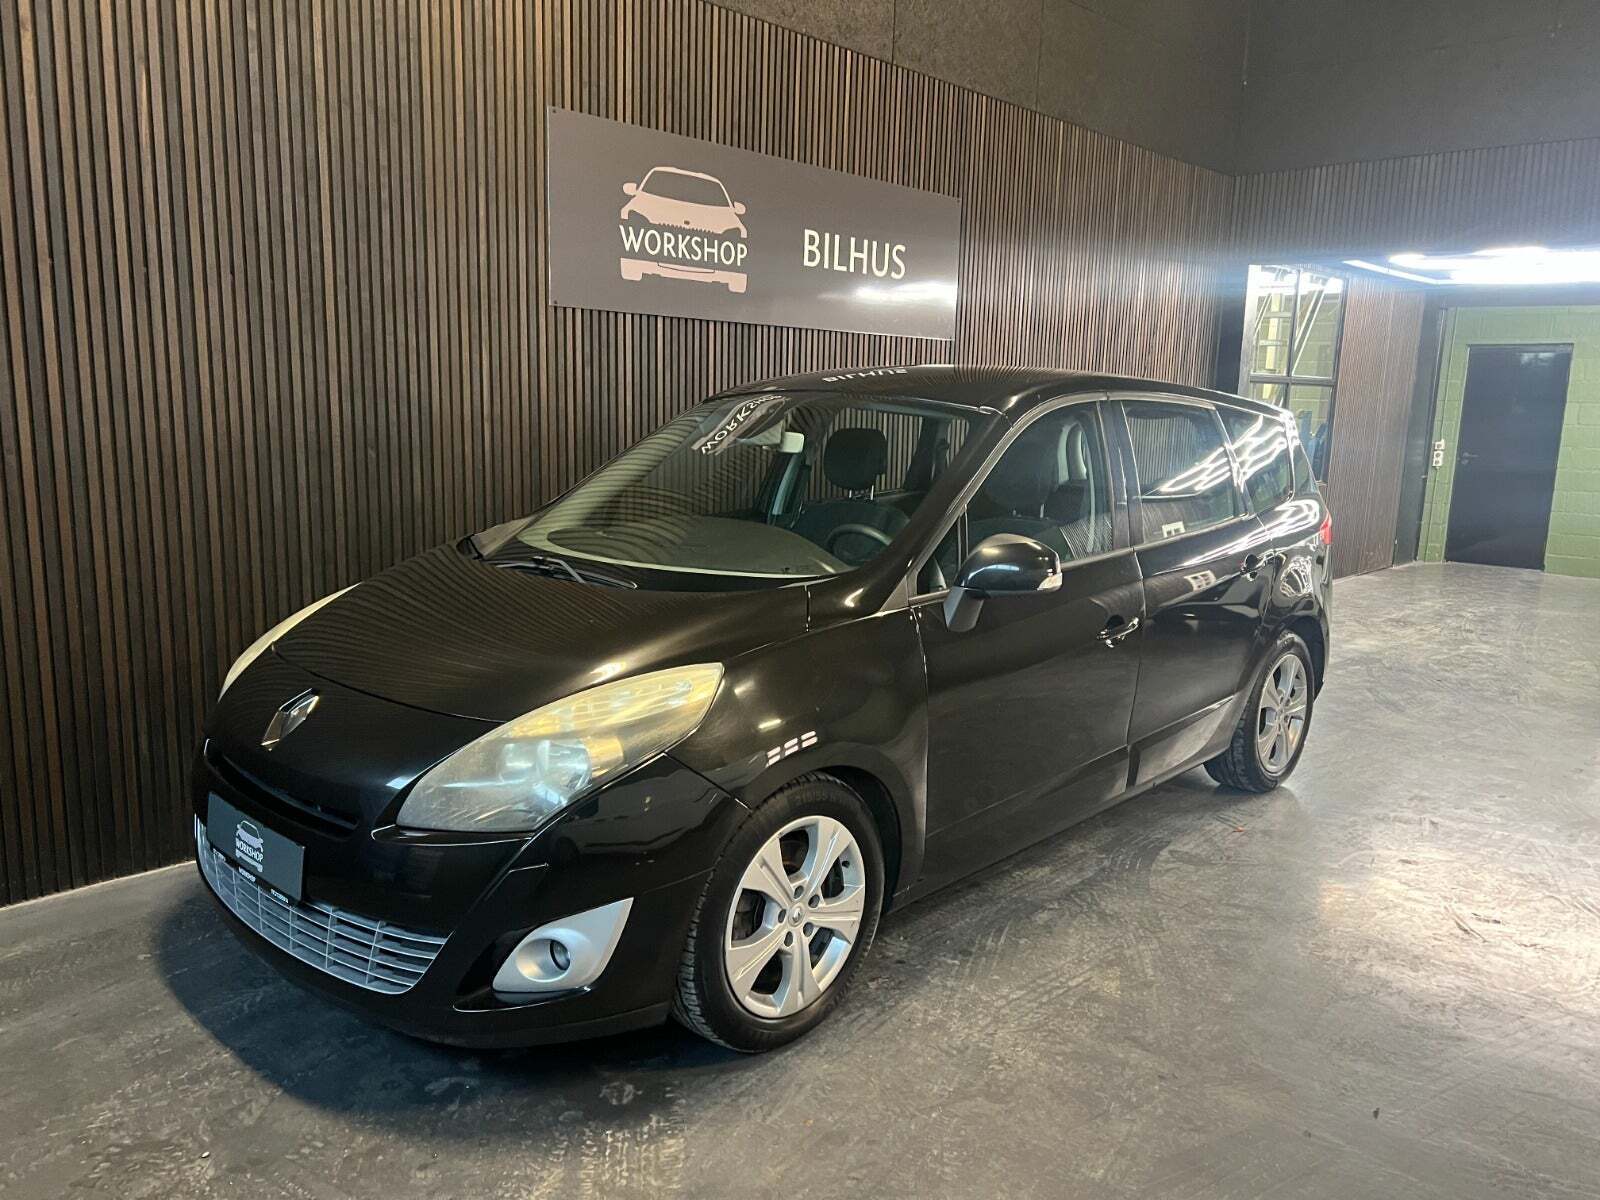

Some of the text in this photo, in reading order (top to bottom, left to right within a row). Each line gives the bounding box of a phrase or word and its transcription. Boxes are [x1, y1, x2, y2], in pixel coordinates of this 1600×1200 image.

[619, 225, 748, 267] WORKSHOP
[803, 229, 906, 280] BILHUS
[236, 838, 264, 863] WORKSHOP
